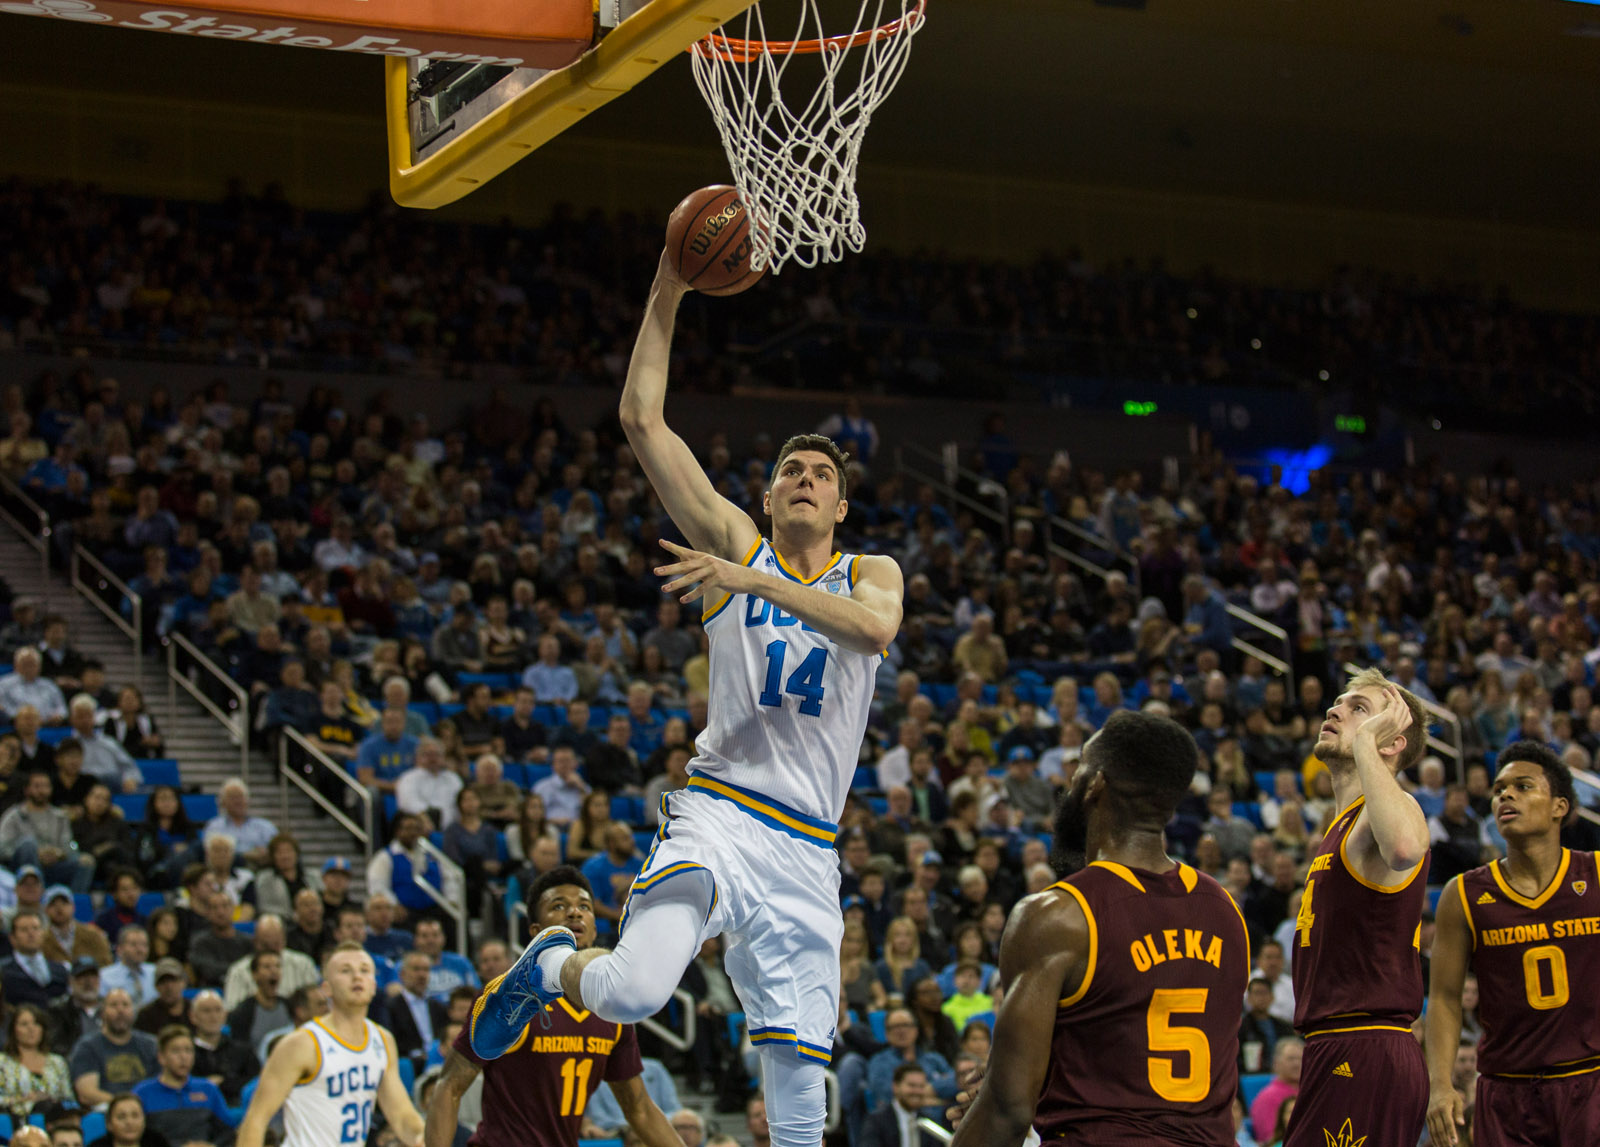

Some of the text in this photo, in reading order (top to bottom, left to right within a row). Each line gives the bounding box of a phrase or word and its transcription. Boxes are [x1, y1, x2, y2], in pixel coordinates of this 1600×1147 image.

[119, 11, 333, 47] State
[689, 199, 744, 256] Wilson
[759, 640, 828, 717] 14
[1130, 928, 1224, 973] OLEKA
[1481, 917, 1600, 947] ARIZONA STATE
[1522, 945, 1570, 1010] 0
[531, 1036, 584, 1053] ARIZONA
[1146, 988, 1211, 1103] 5
[560, 1057, 594, 1117] 11
